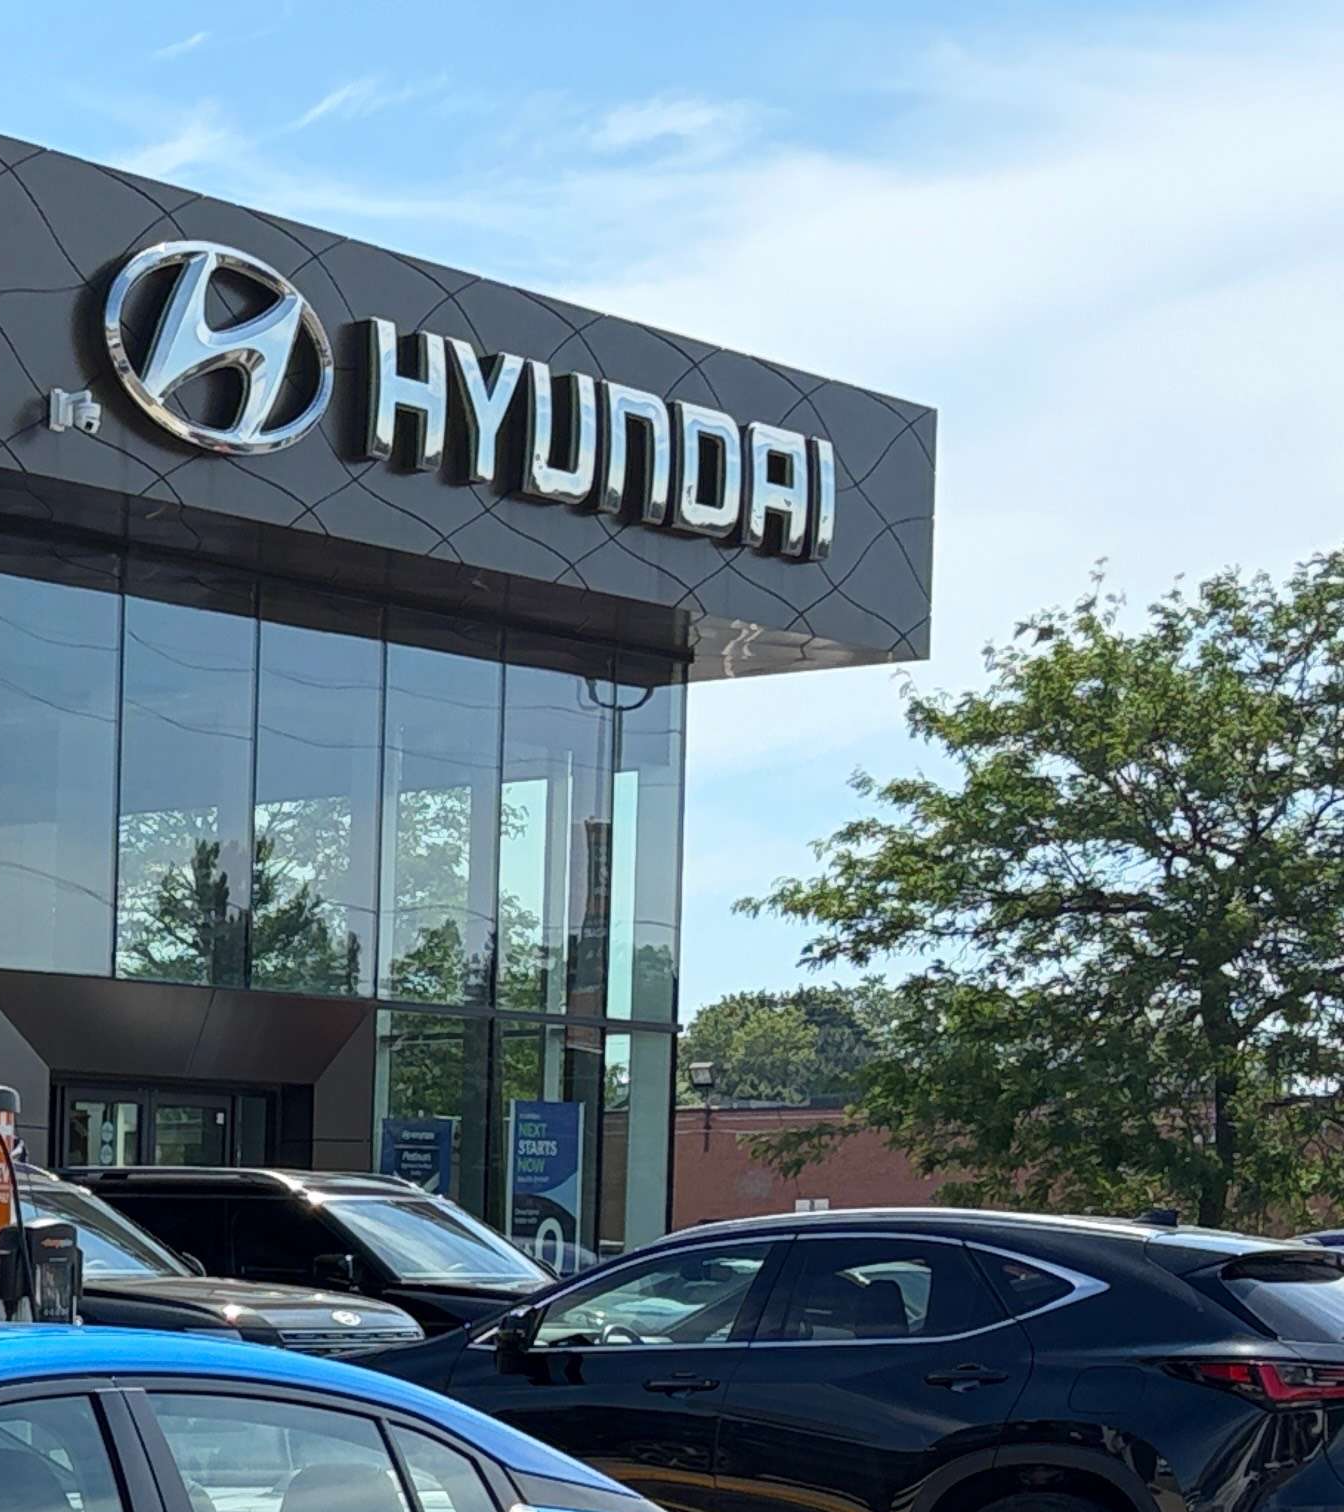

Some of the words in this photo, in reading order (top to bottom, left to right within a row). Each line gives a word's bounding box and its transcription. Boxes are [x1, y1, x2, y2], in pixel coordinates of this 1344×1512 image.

[368, 316, 835, 562] HYUNDAI
[518, 1122, 547, 1138] NEXT
[517, 1140, 558, 1157] STARTS
[517, 1157, 545, 1173] NOW
